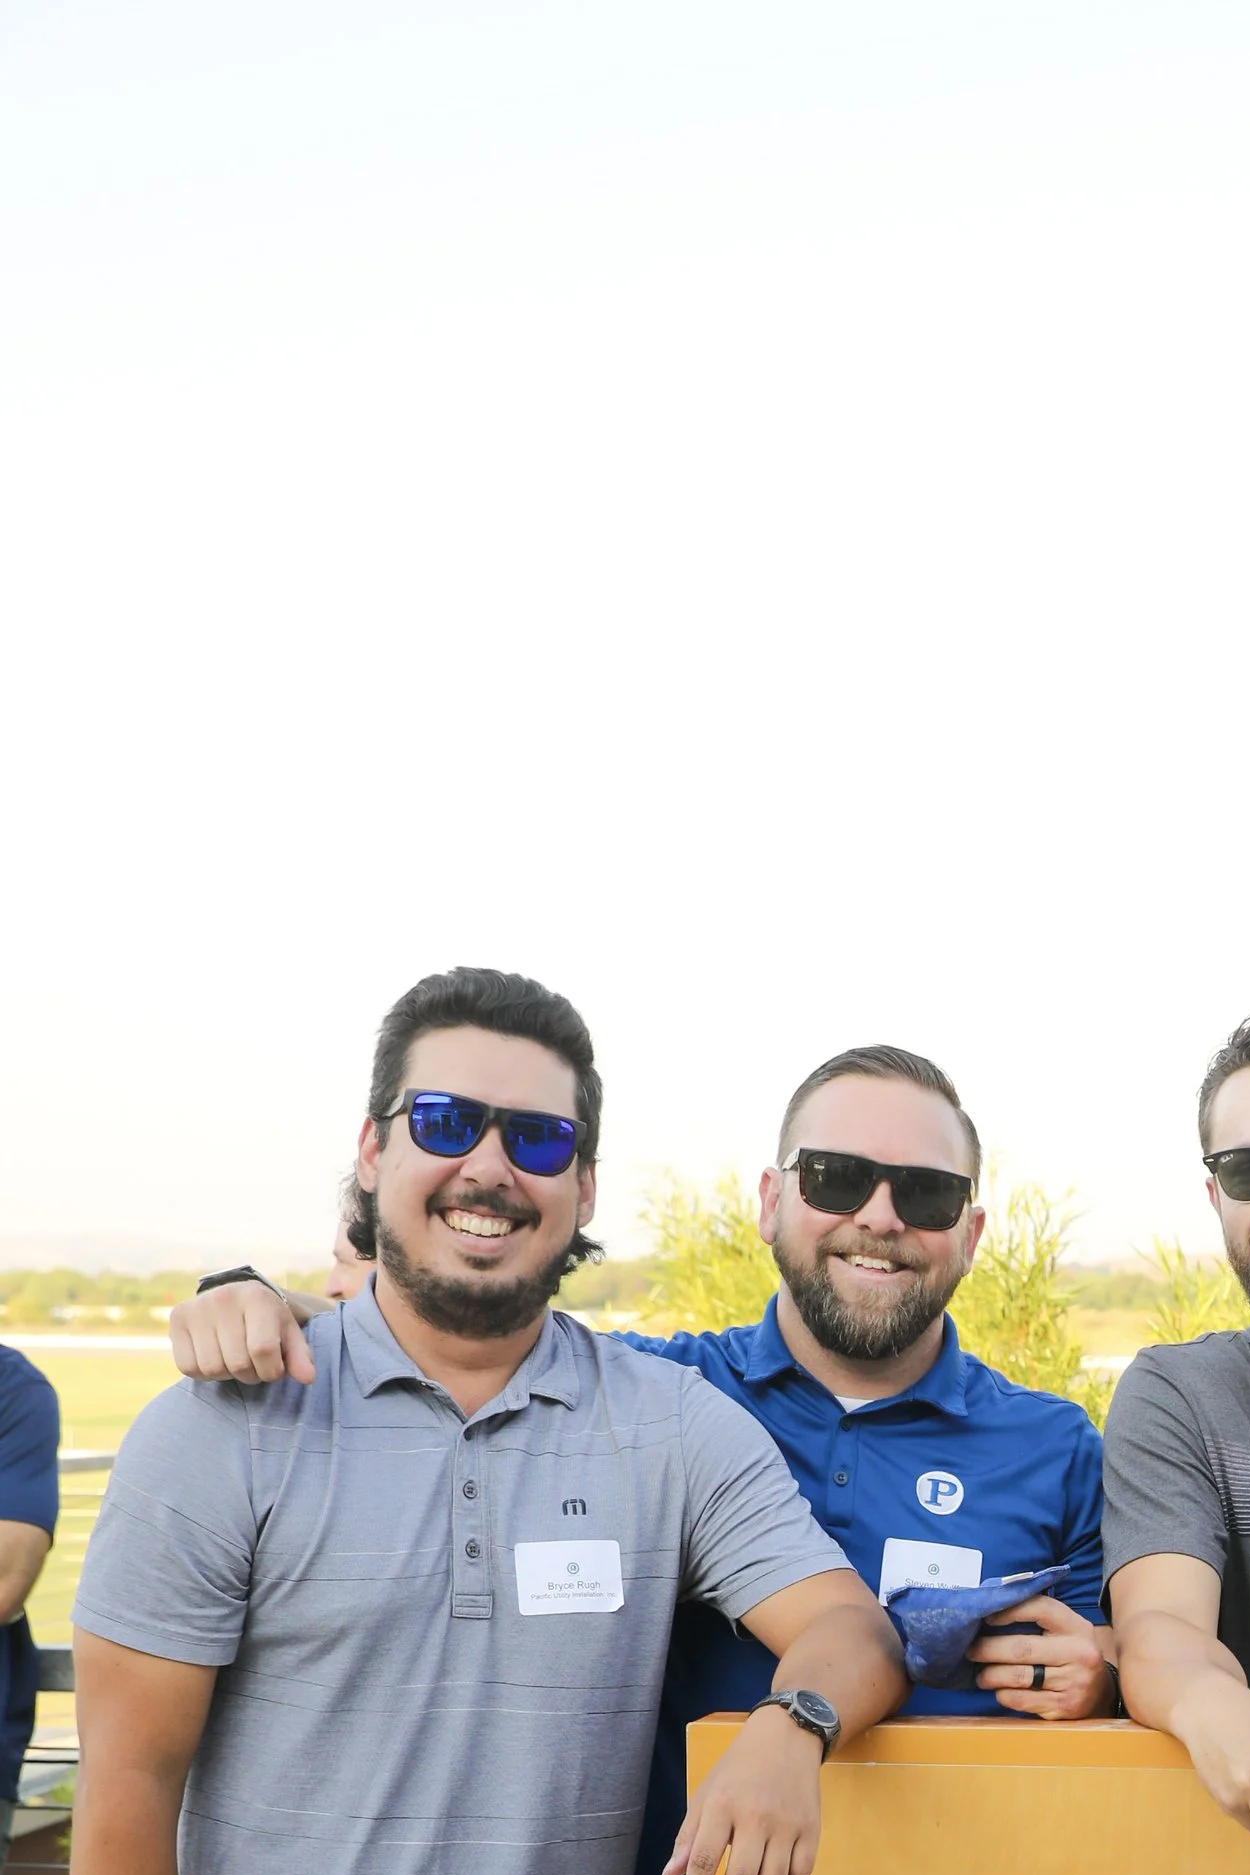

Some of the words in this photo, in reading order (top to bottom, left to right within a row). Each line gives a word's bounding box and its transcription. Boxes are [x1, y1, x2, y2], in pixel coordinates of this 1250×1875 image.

[924, 1478, 958, 1507] P
[547, 1581, 575, 1592] Bryce
[577, 1580, 601, 1591] Rugh
[553, 1591, 571, 1600] Utility
